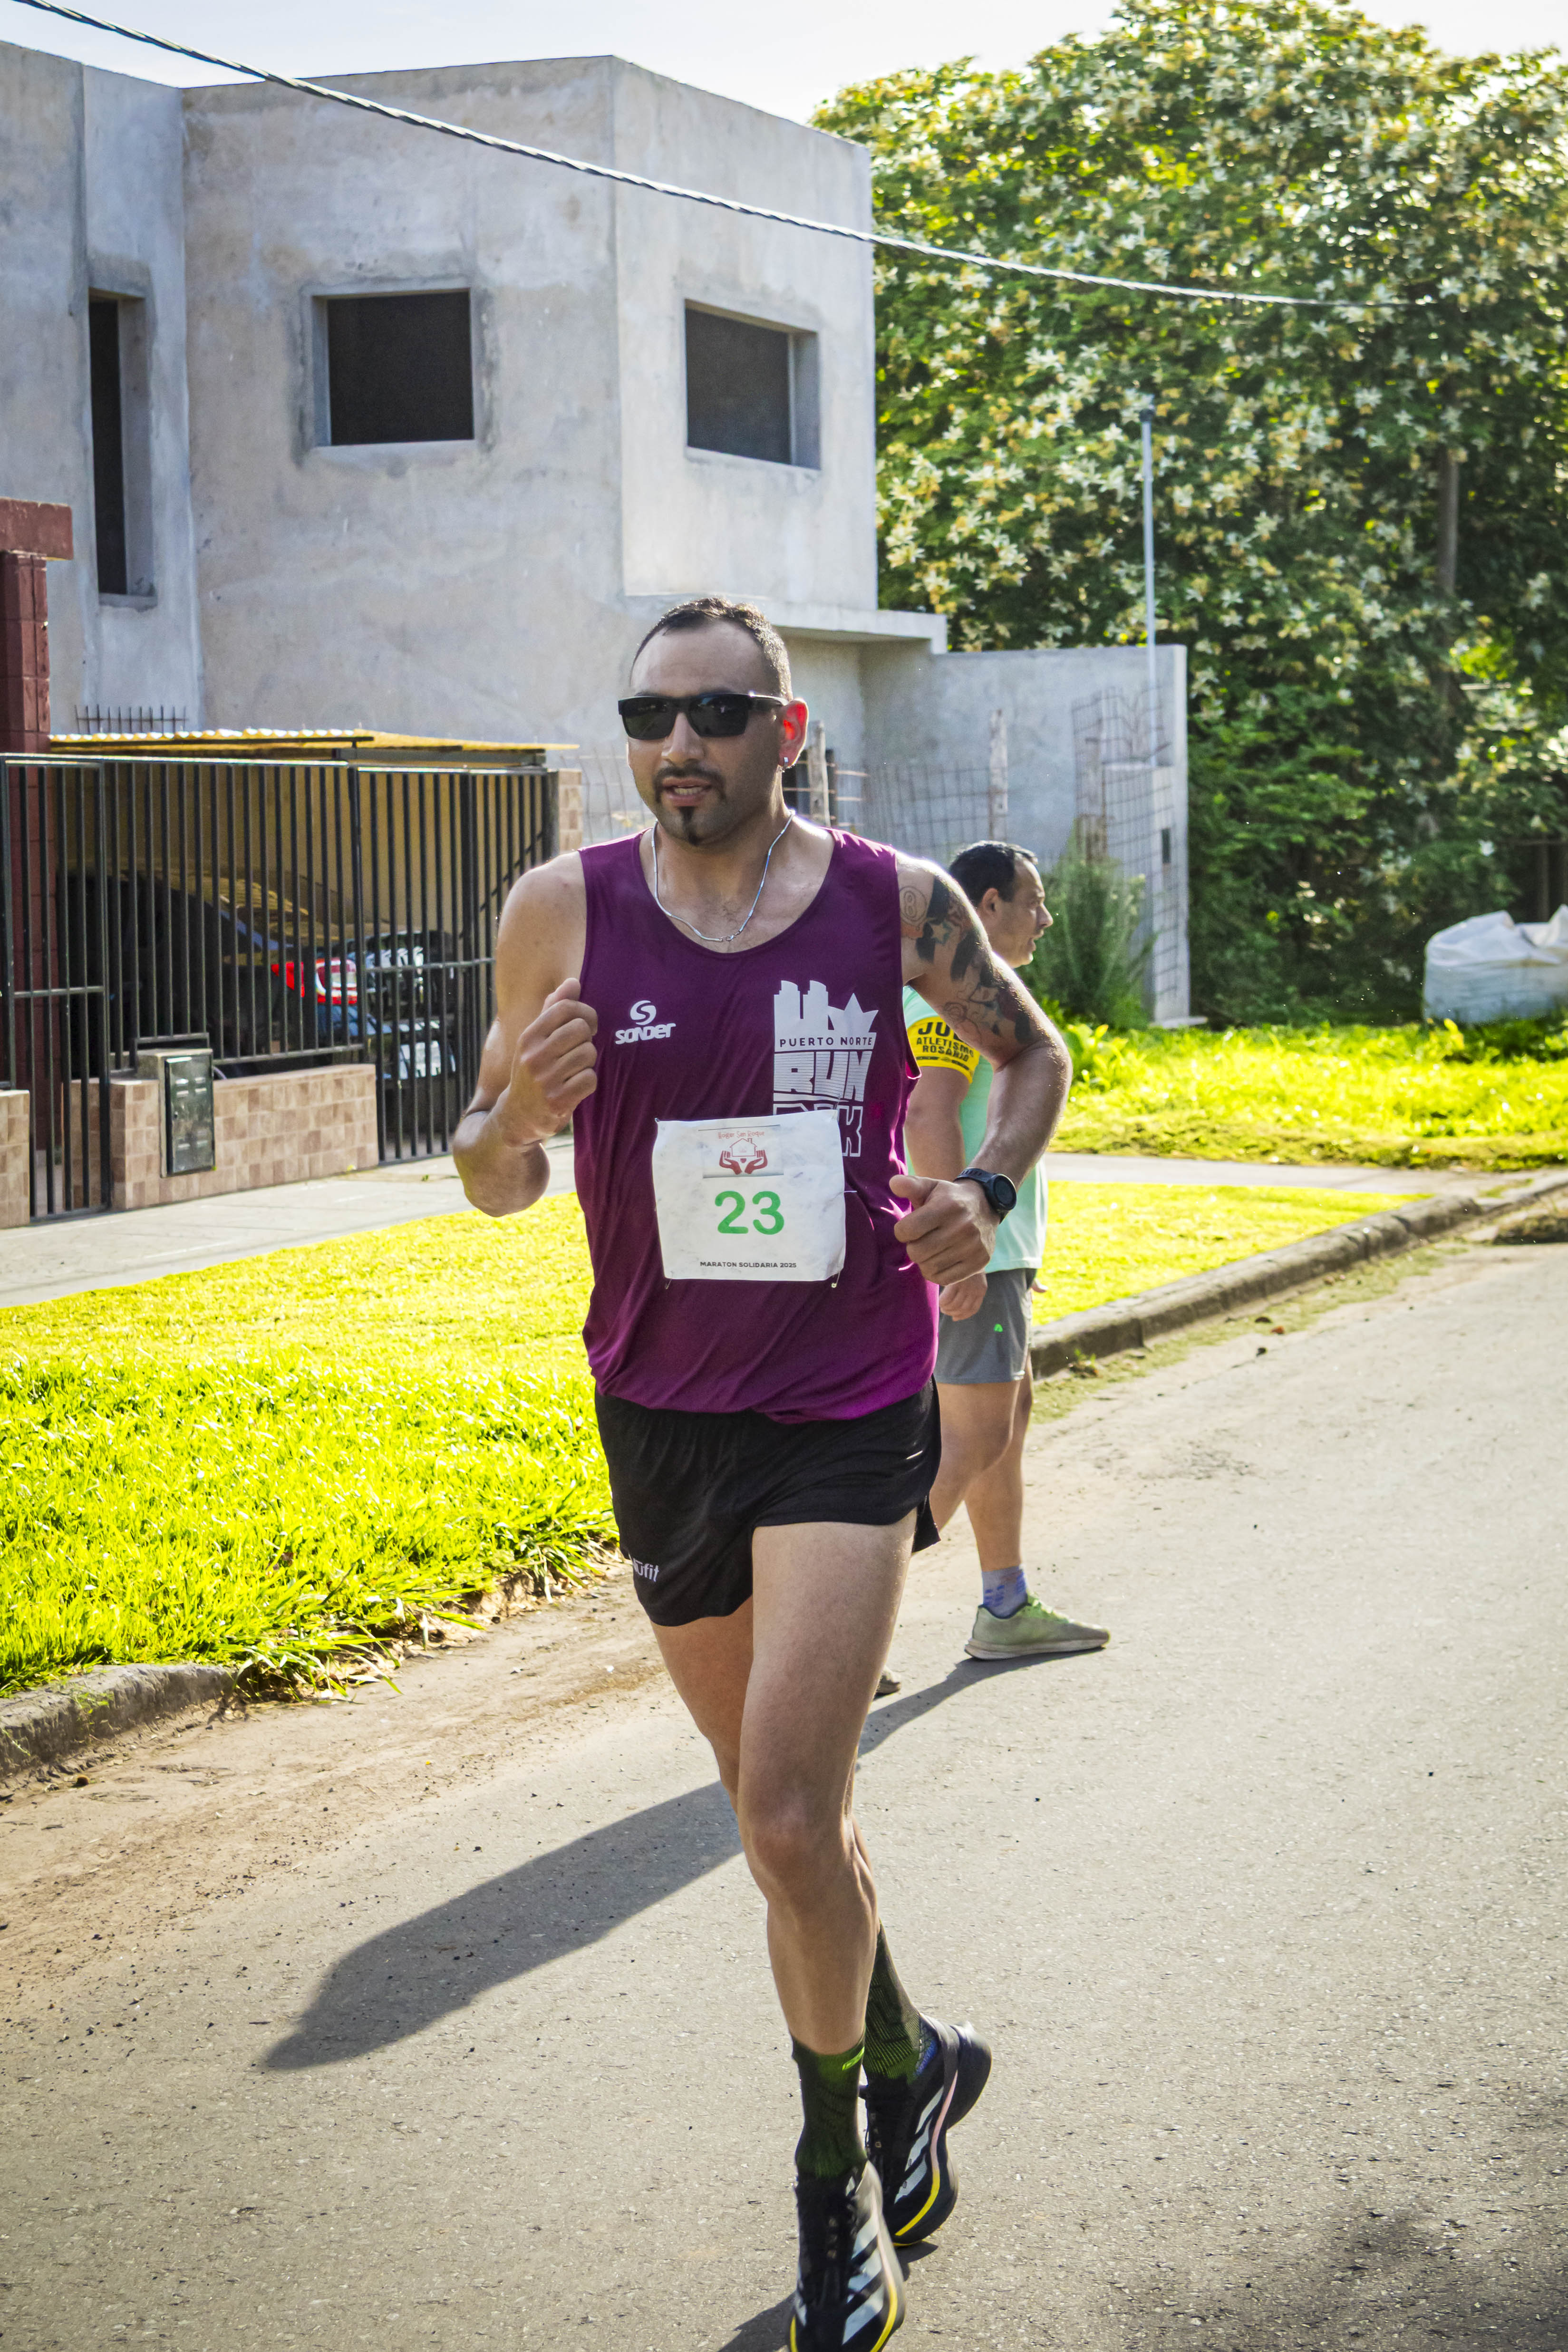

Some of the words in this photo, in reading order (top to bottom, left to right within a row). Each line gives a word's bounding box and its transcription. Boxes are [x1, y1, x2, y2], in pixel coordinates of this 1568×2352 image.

[780, 1037, 834, 1047] PUERTO
[840, 1036, 872, 1045] NORTE
[917, 1037, 974, 1057] ATLETISMO
[923, 1045, 969, 1062] ROSARIO
[774, 1051, 872, 1102] RUN
[715, 1191, 784, 1235] 23
